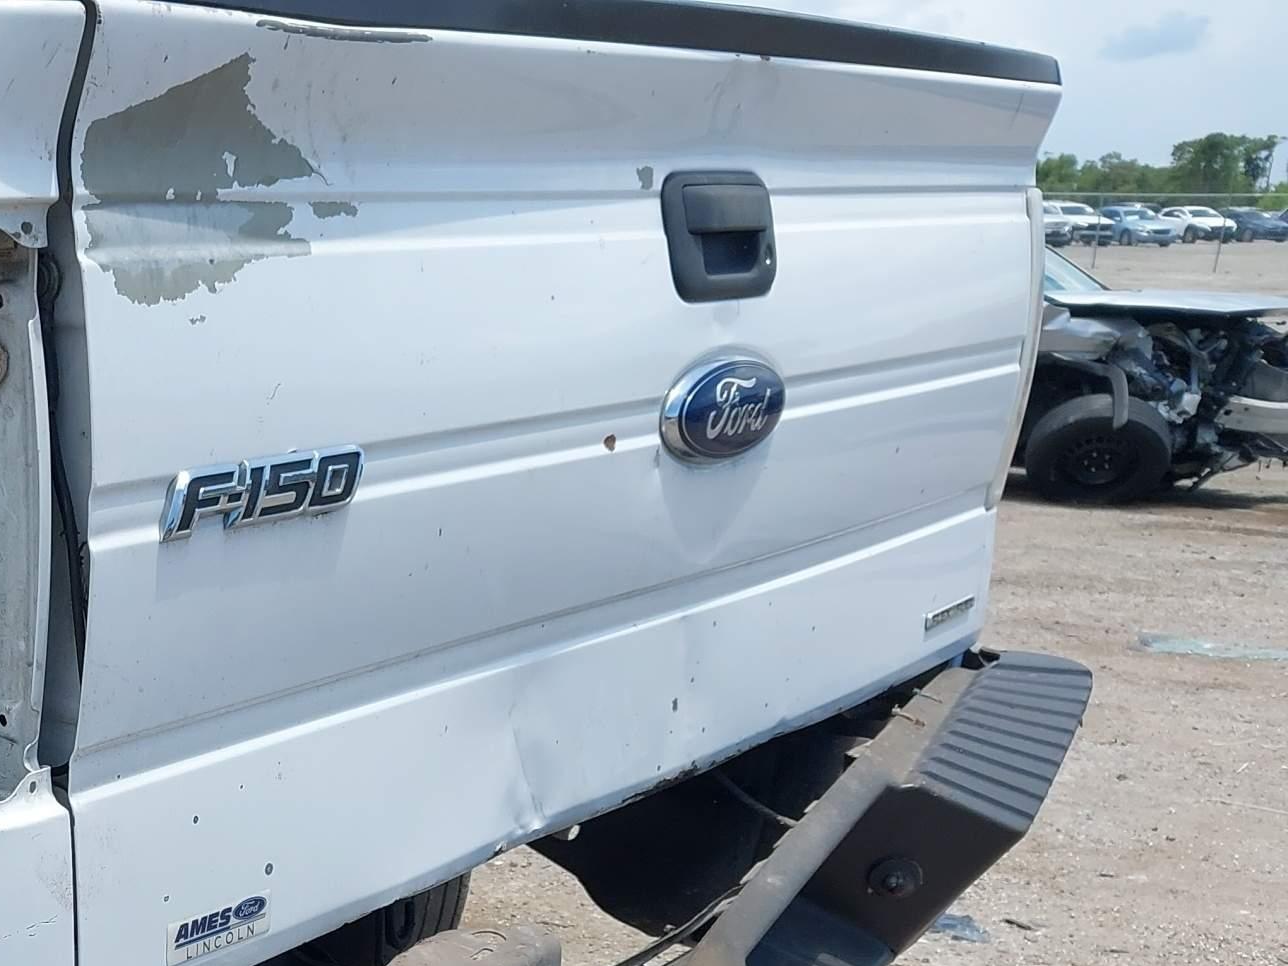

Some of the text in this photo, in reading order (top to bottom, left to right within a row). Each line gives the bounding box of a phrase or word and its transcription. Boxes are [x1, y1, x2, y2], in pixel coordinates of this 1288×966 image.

[706, 377, 771, 439] Ford
[160, 446, 364, 543] F-150
[175, 906, 232, 943] AMES
[186, 922, 255, 960] LINCOLN
